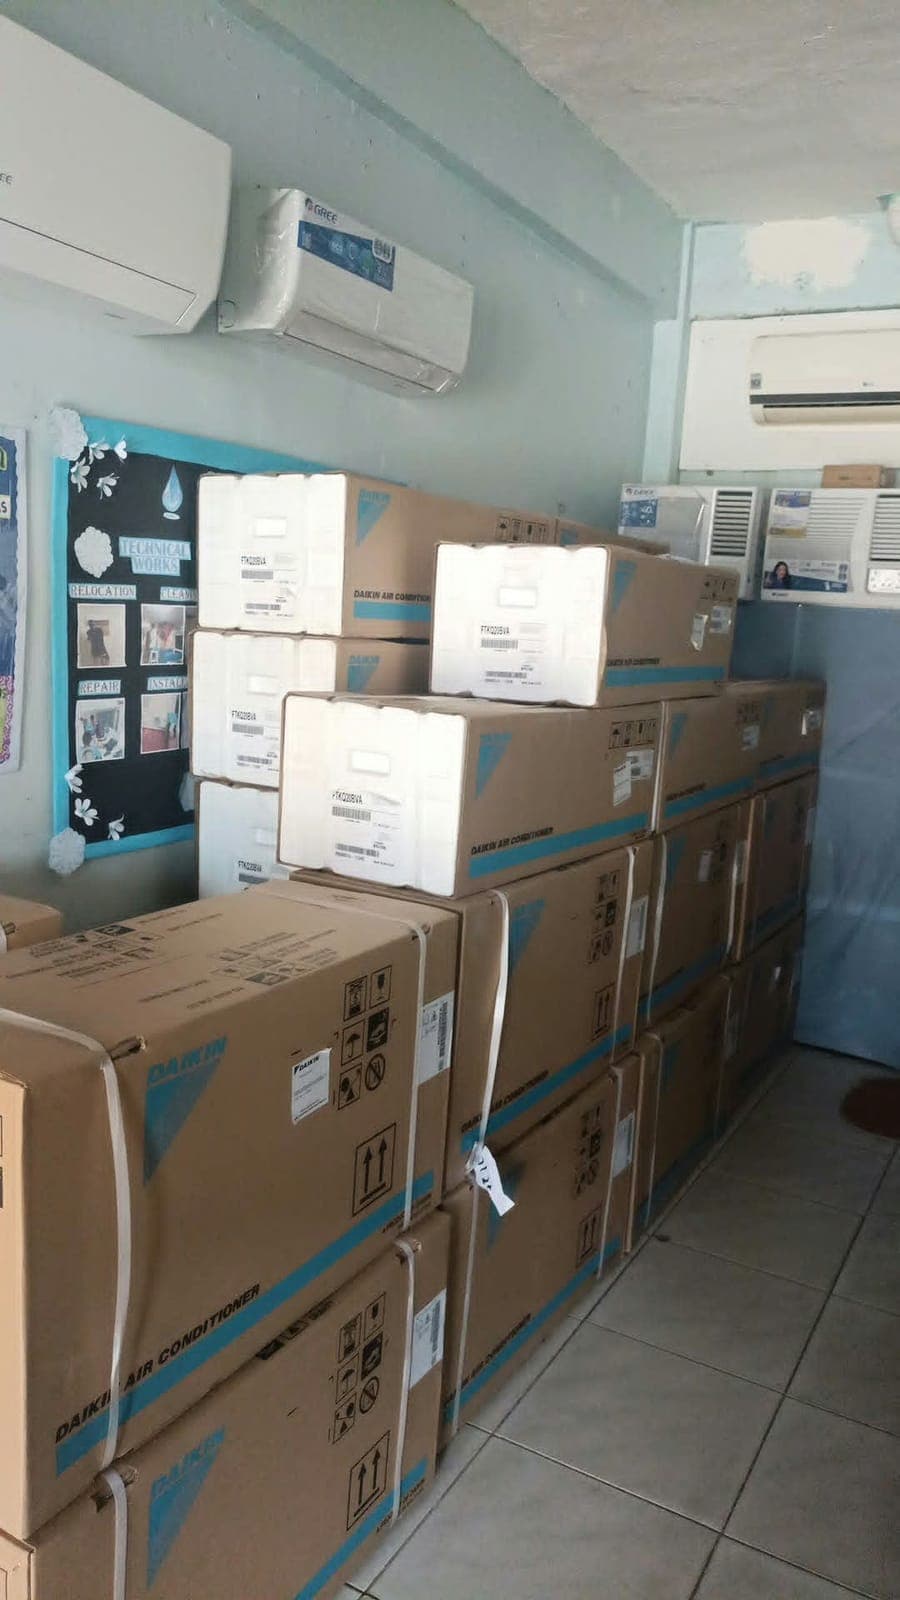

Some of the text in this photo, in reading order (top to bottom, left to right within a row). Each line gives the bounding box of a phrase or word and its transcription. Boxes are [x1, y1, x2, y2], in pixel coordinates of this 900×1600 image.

[314, 204, 338, 224] GREE
[120, 540, 187, 557] TECHNICAL
[135, 558, 179, 573] WORKS
[71, 585, 135, 598] RELOCATION
[353, 590, 381, 599] DAIKIN
[381, 592, 394, 600] AIR
[79, 681, 120, 694] REPAIR
[148, 1036, 228, 1085] DAIKIN
[123, 1359, 154, 1391] AIR
[158, 1283, 260, 1365] CONDITIONER
